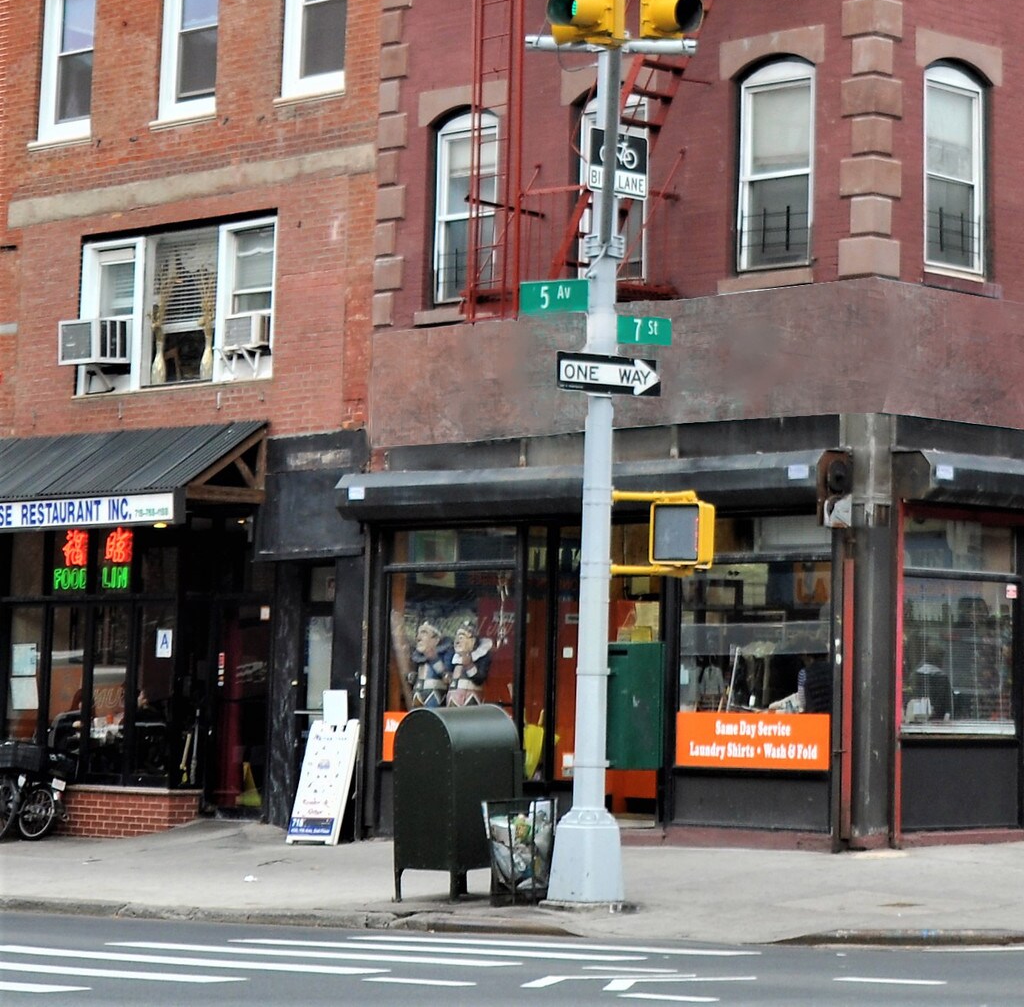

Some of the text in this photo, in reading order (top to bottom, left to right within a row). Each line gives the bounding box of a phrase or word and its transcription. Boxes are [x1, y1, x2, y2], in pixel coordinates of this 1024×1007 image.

[618, 175, 644, 193] LANE
[540, 285, 571, 309] 5 Av
[633, 319, 658, 341] 7 St
[564, 364, 651, 385] ONE WAY
[21, 500, 101, 525] RESTAURANT
[108, 498, 132, 520] INC.
[102, 566, 128, 589] LIN
[160, 633, 169, 648] A
[716, 720, 791, 739] Same Day Service
[689, 741, 818, 760] Laundry Shirts Wash & Fold
